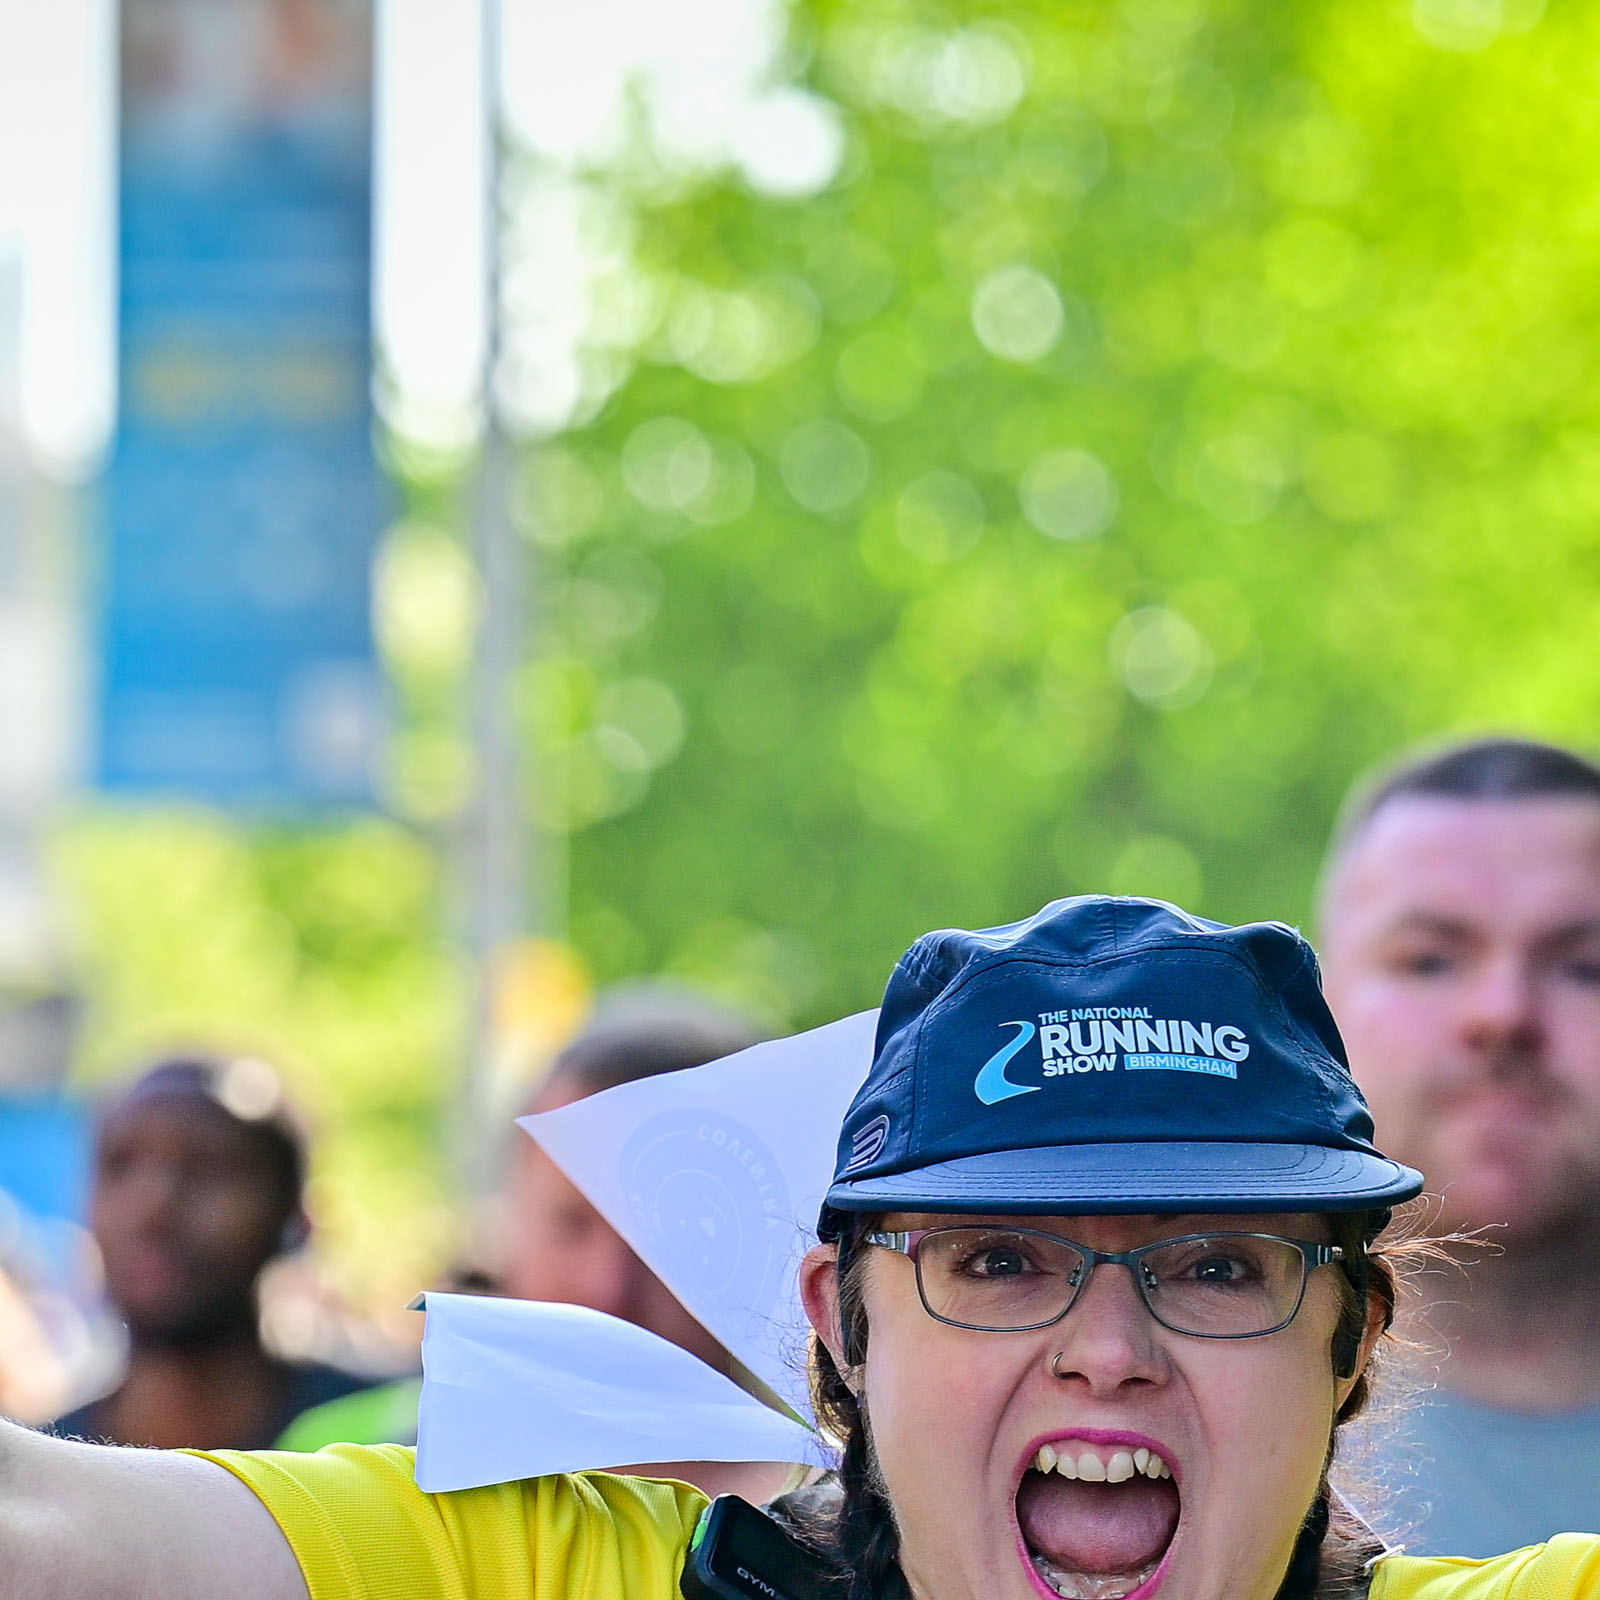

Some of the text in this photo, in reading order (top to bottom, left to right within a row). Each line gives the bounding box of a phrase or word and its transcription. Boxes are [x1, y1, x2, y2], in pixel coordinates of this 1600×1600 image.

[1038, 1007, 1153, 1025] THE NATIONAL
[1039, 1019, 1250, 1062] RUNNING
[1042, 1054, 1234, 1077] SHOW BIRMINGHAM
